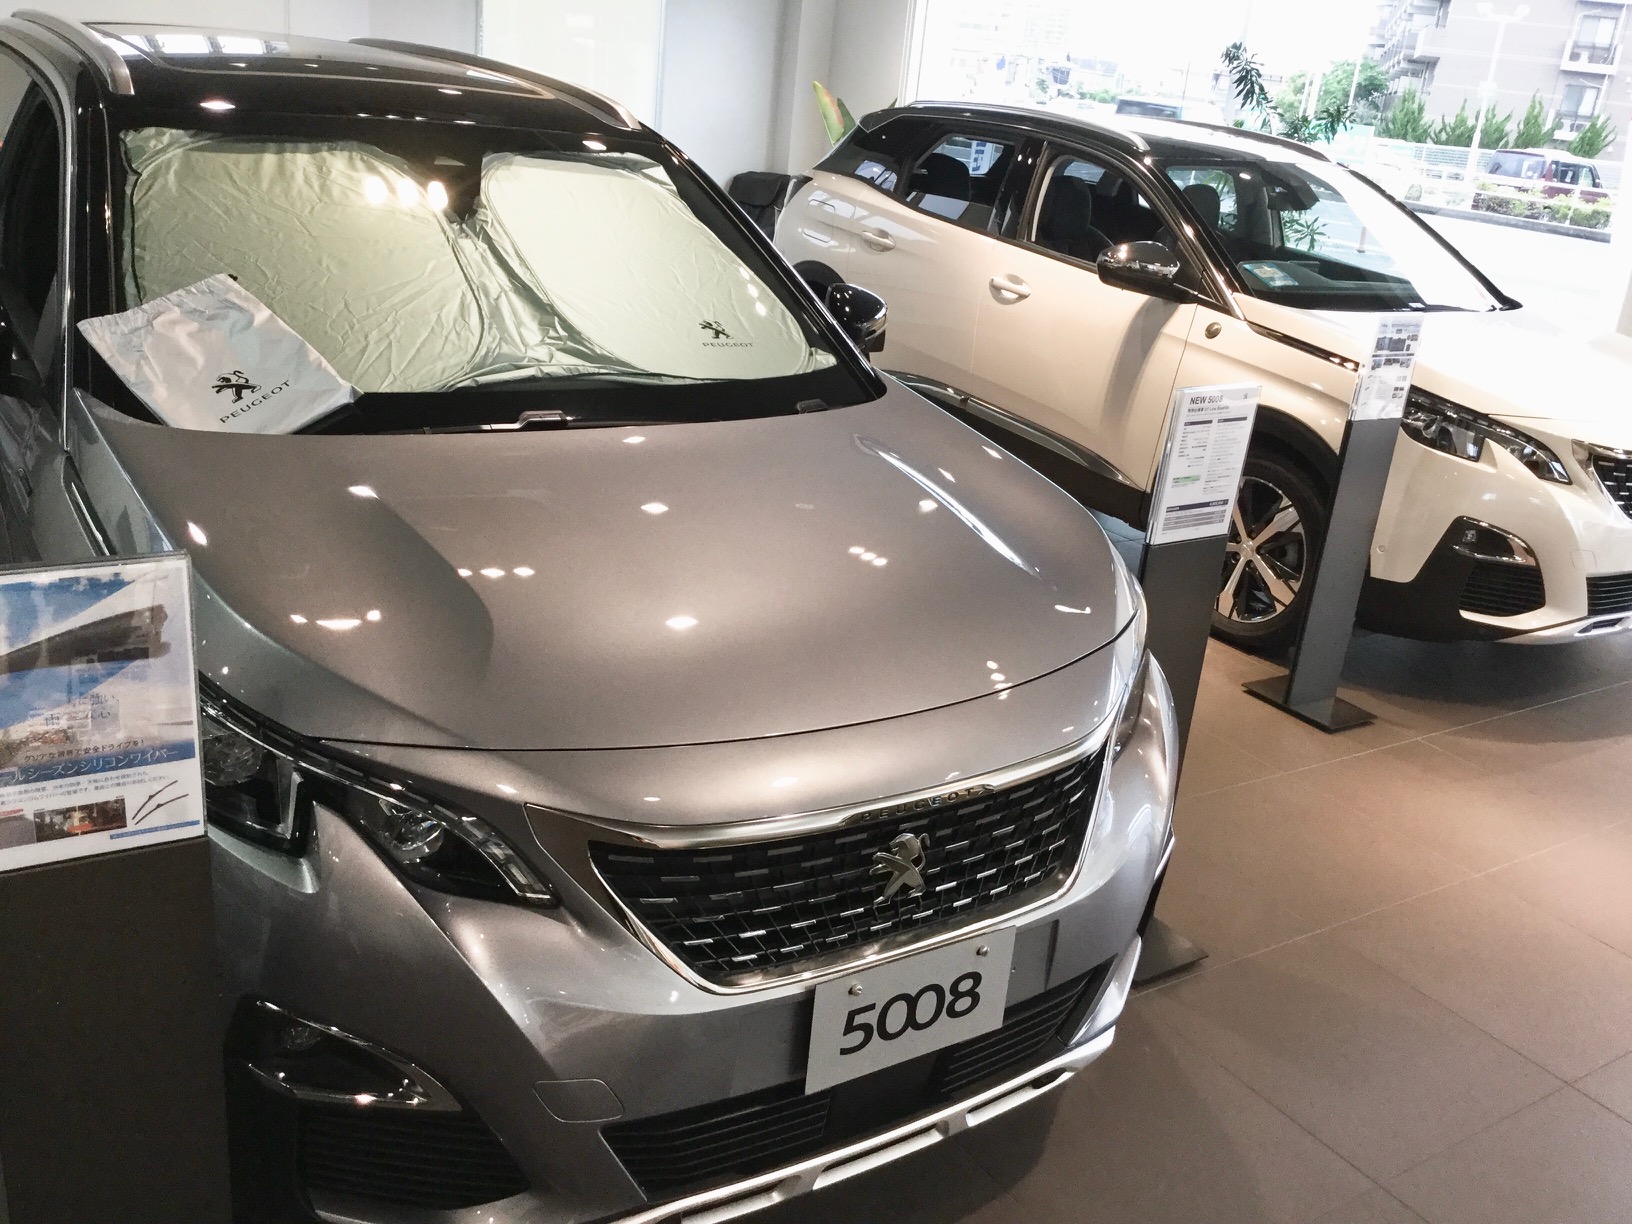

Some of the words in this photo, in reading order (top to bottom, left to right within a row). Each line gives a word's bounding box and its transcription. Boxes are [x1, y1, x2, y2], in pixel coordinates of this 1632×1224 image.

[219, 379, 290, 424] PEUGEOT
[1190, 396, 1207, 405] NEW
[1208, 395, 1223, 404] 5008
[861, 787, 974, 820] PEUGEOT
[839, 971, 983, 1056] 5008
